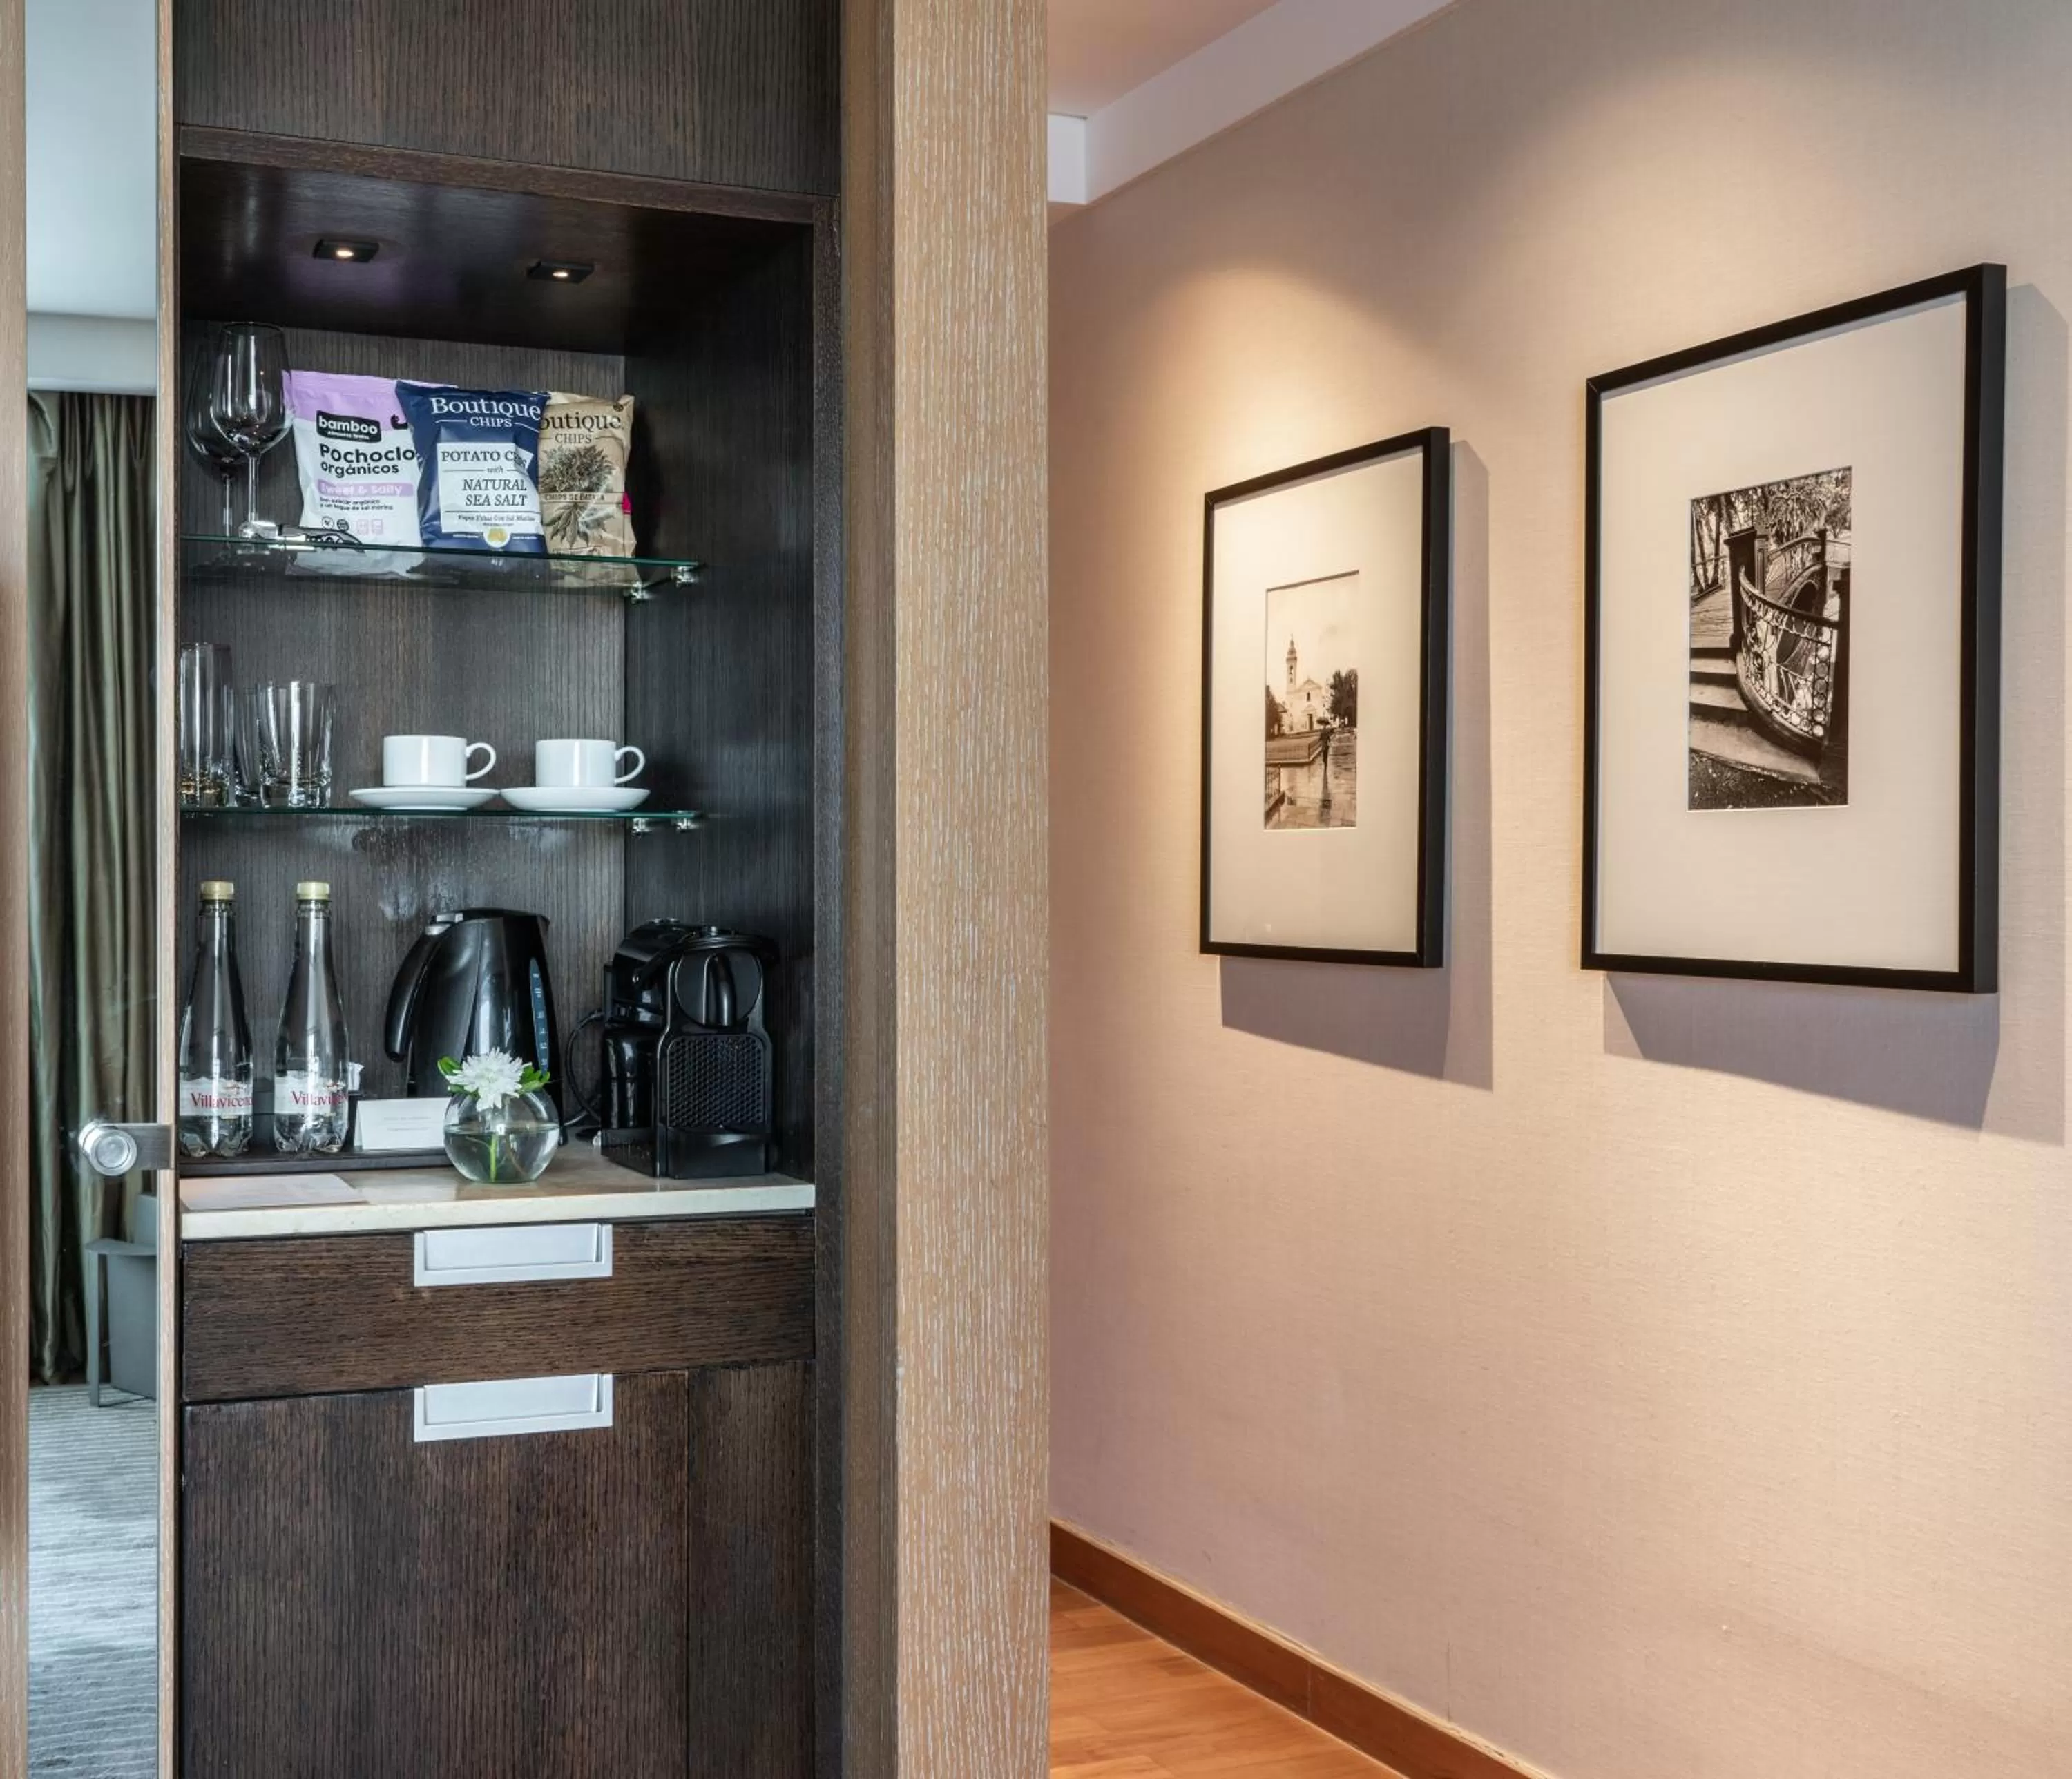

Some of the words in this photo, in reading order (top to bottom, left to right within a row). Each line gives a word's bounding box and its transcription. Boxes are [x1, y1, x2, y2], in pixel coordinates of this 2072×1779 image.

[429, 397, 541, 420] Boutique
[318, 416, 378, 434] bamboo
[470, 416, 512, 427] CHIPS
[540, 412, 622, 432] outique
[555, 433, 592, 444] CHIPS
[441, 450, 501, 462] POTATO
[320, 461, 399, 479] orgánicos
[461, 479, 528, 491] NATURAL
[465, 494, 491, 506] SEA
[494, 494, 528, 506] SALT
